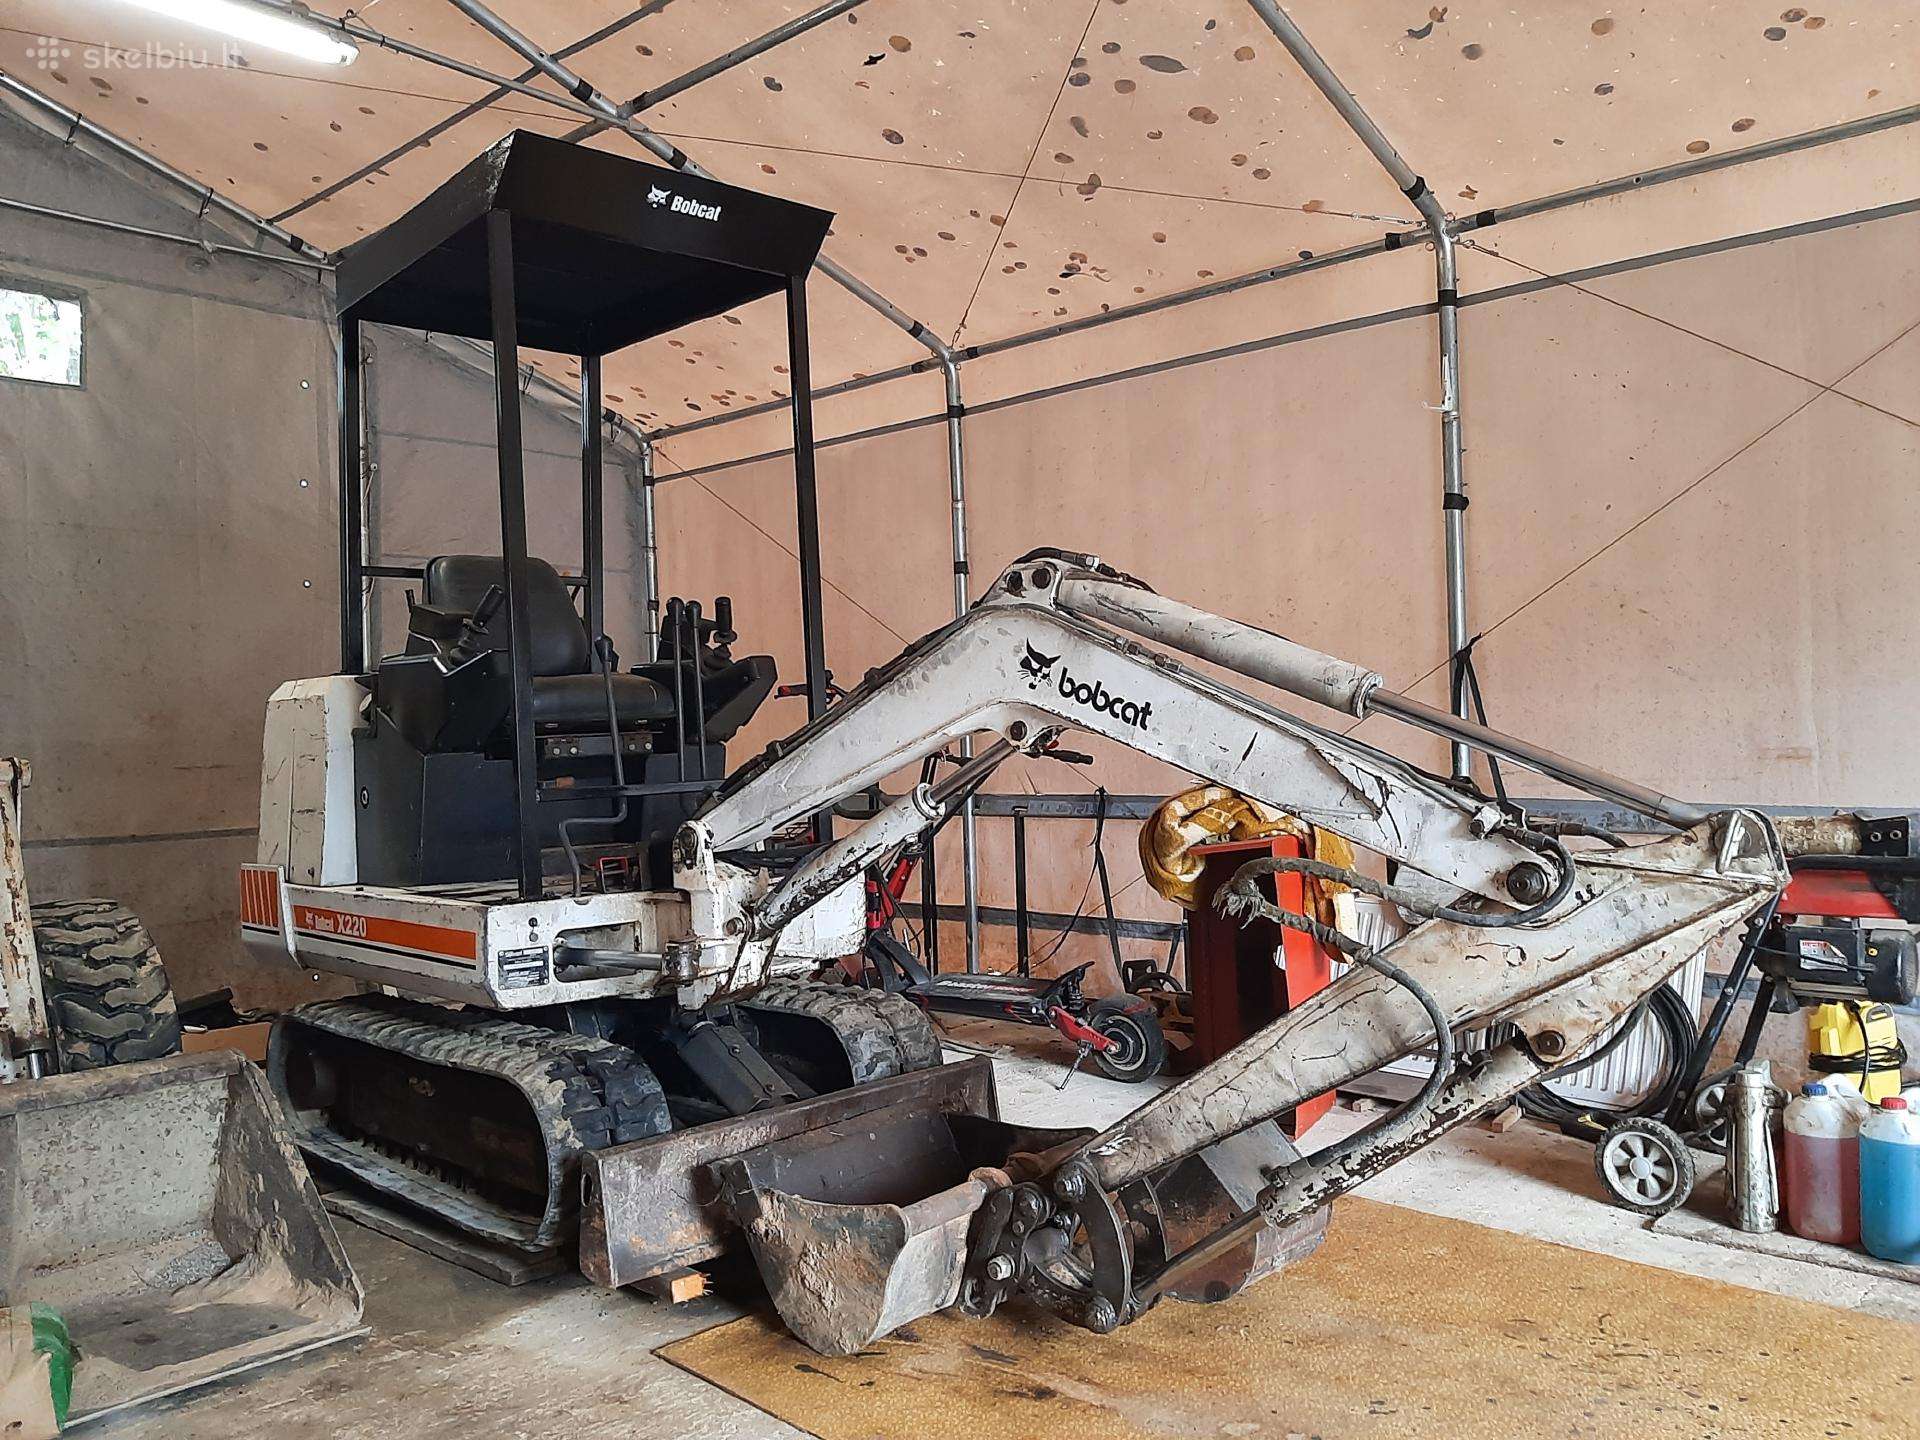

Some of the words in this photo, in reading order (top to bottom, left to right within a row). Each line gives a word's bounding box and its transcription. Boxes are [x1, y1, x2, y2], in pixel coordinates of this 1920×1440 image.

[671, 195, 721, 221] Bobcat
[1058, 666, 1153, 731] bobcat
[336, 913, 367, 938] X220
